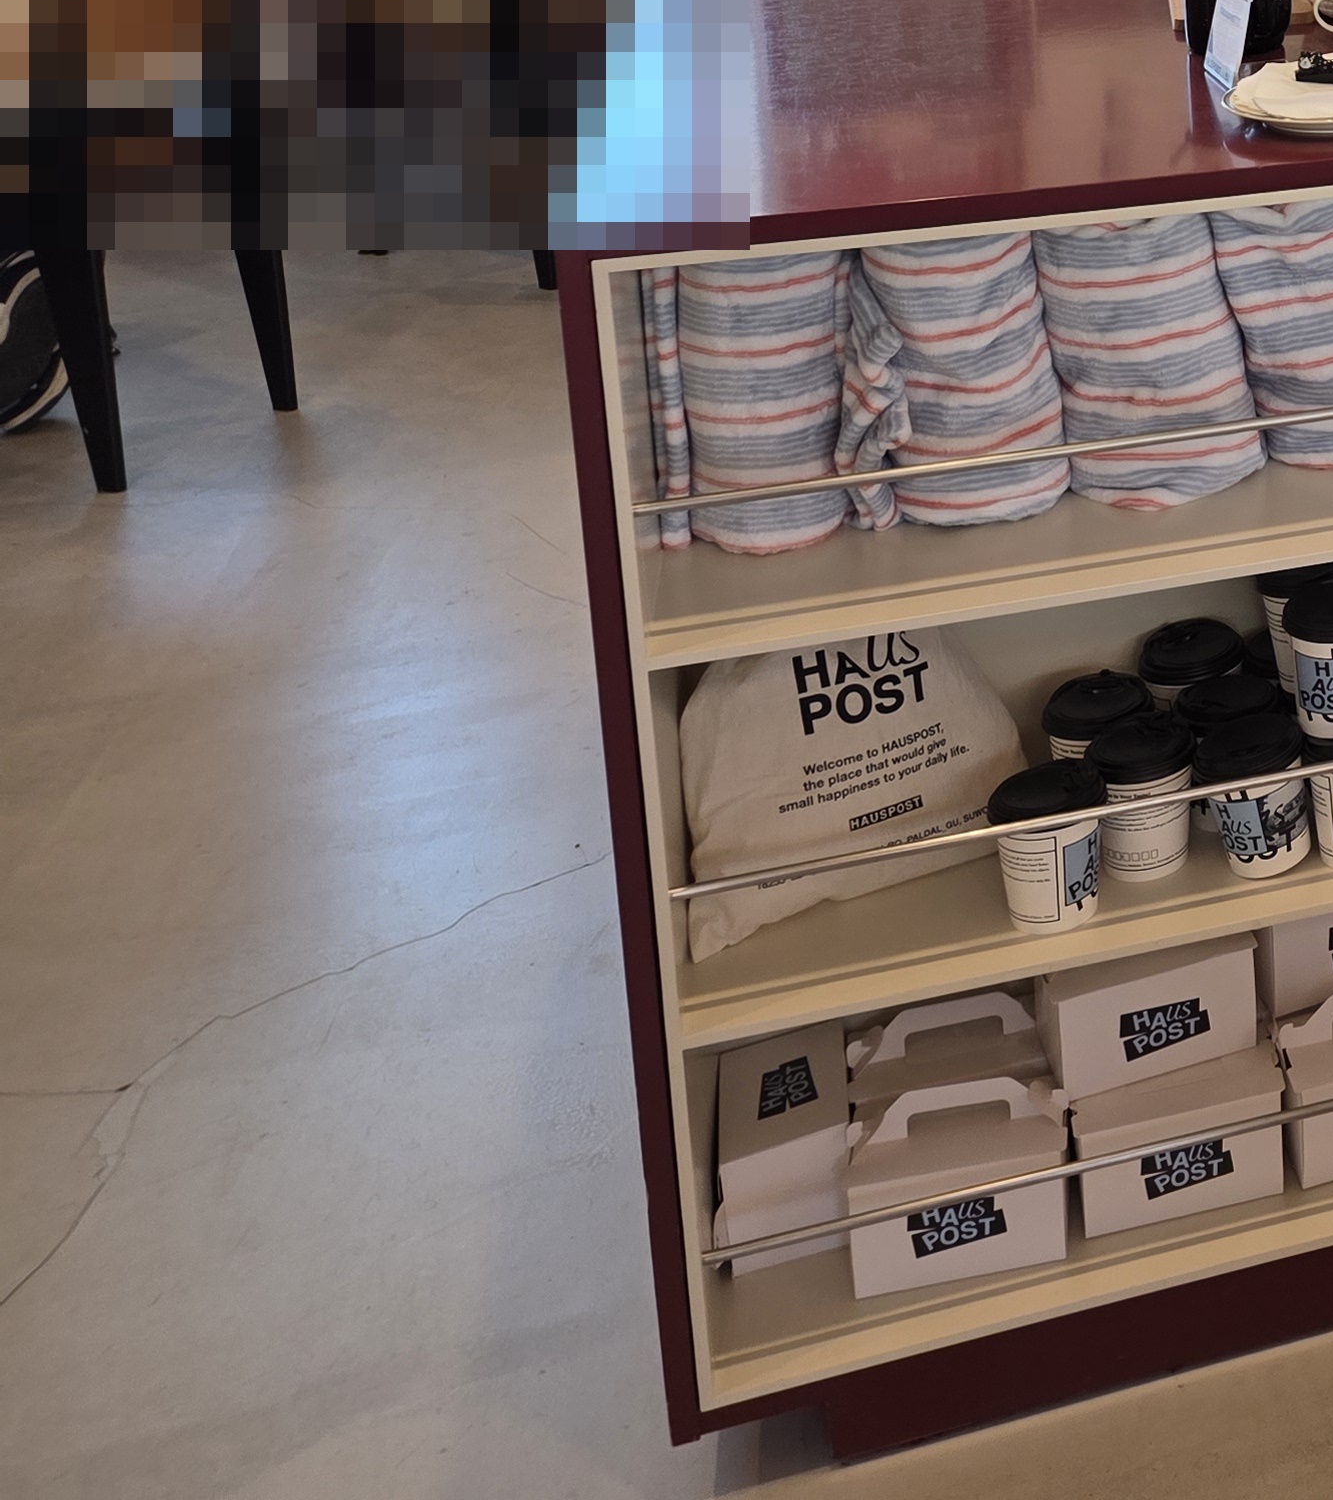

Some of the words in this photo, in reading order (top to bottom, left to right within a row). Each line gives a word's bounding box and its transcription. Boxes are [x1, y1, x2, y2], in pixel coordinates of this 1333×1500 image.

[792, 630, 920, 694] HAUS
[799, 661, 929, 736] POST
[802, 753, 863, 776] Welcome
[866, 747, 879, 758] to
[881, 722, 945, 754] HAUSPOST,
[803, 778, 825, 792] the
[828, 769, 863, 789] place
[865, 760, 889, 775] that
[892, 746, 925, 765] would
[926, 737, 947, 755] give
[778, 796, 814, 814] small
[817, 778, 881, 804] happiness
[883, 771, 895, 783] to
[898, 762, 923, 780] your
[924, 751, 948, 770] daily
[950, 746, 970, 759] life.
[850, 795, 923, 831] HAUSPOST
[962, 806, 988, 824] SUWO
[1132, 1001, 1191, 1031] HAUS
[1133, 1017, 1200, 1055] POST
[789, 1062, 812, 1104] POST
[1153, 1140, 1215, 1170] HAUS
[1154, 1158, 1224, 1193] POST
[921, 1199, 986, 1228] HAUS
[921, 1217, 996, 1251] POST
